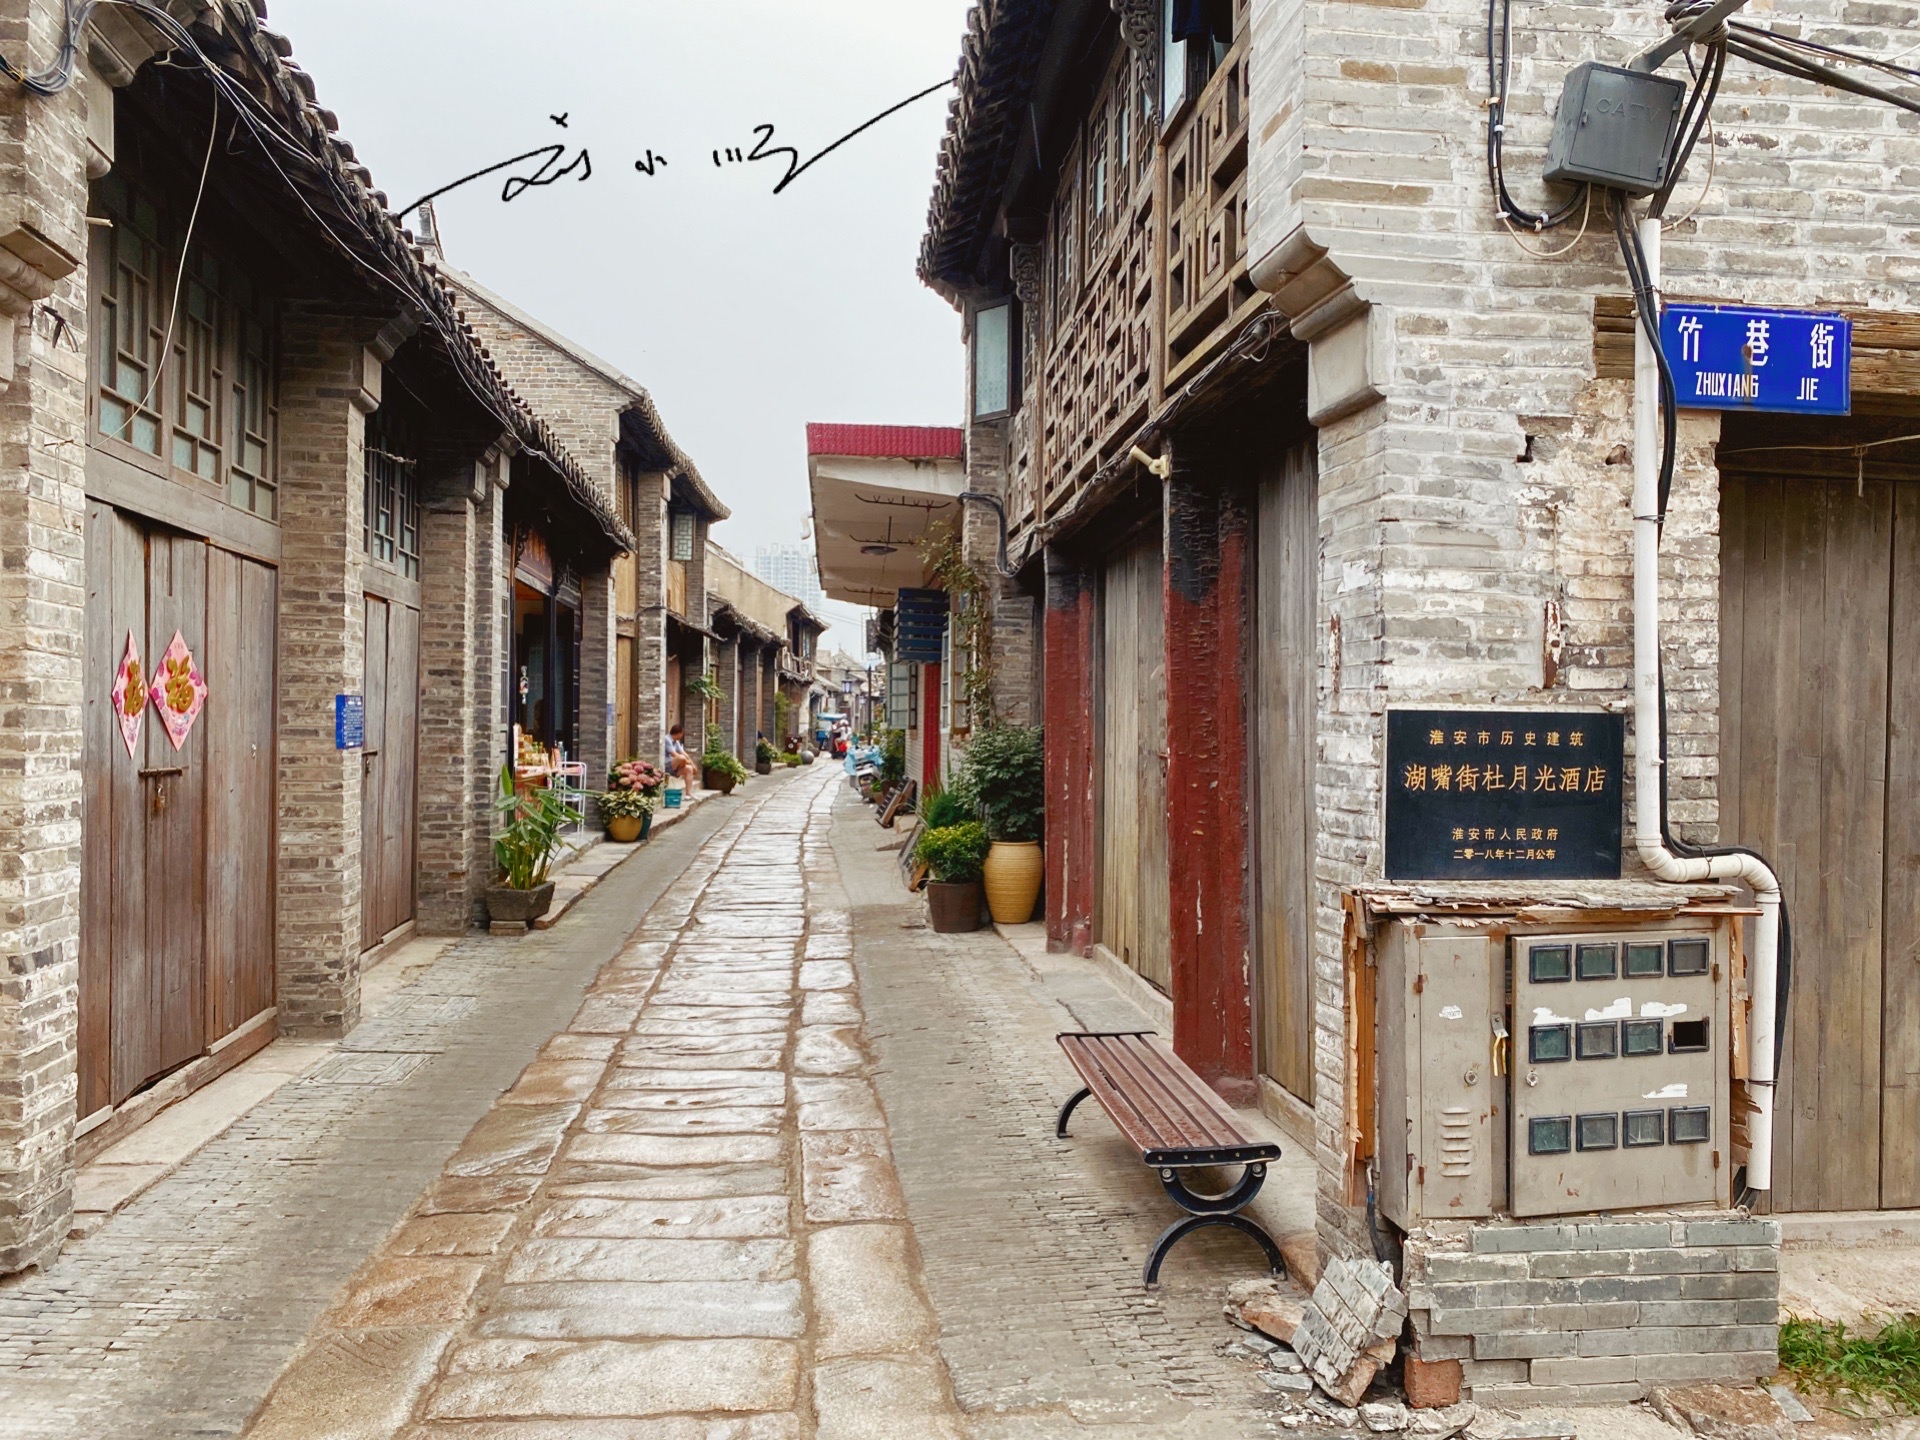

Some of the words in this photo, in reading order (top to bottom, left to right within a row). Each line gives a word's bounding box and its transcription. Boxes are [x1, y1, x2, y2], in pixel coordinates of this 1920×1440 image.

[1596, 97, 1661, 122] CATV
[1678, 315, 1834, 369] 竹巷街
[1695, 371, 1759, 398] ZHUXIANG
[1796, 377, 1819, 401] JIE
[1429, 729, 1584, 747] 淮安市历史建筑
[1404, 763, 1607, 793] 湖嘴街杜月光酒店
[1452, 827, 1559, 841] 淮安市人民政府
[1453, 848, 1556, 861] 二零一八年十二月公布
